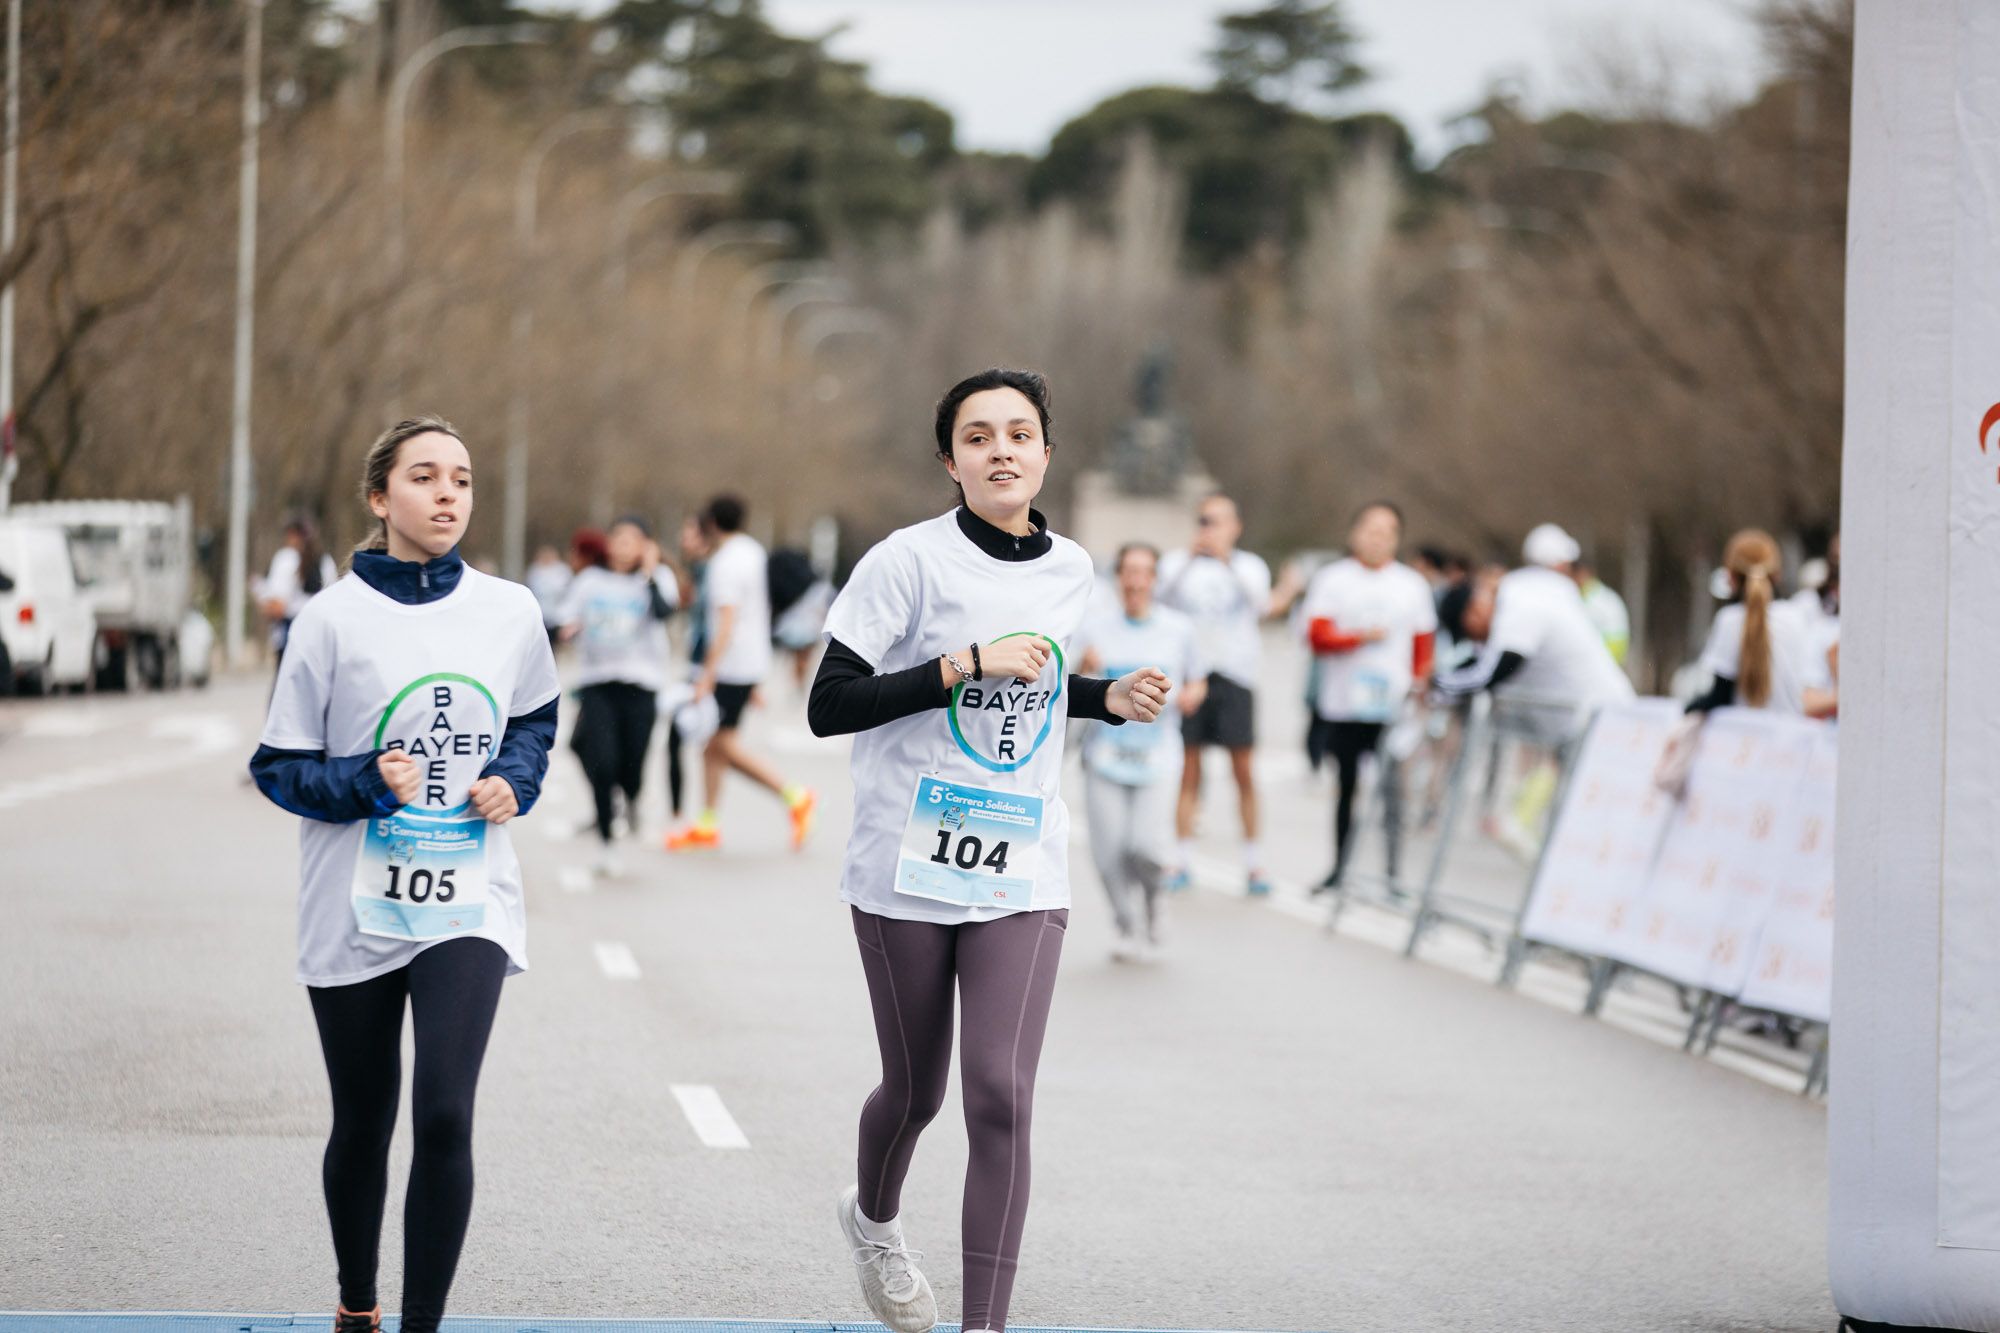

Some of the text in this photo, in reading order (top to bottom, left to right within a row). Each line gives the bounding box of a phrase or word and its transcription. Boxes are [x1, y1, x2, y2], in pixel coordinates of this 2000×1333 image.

[962, 688, 1050, 712] BAYER
[426, 686, 452, 806] BAYER
[945, 792, 984, 807] Carrera
[985, 799, 1025, 814] Solidaria
[931, 829, 1010, 874] 104
[385, 865, 456, 903] 105
